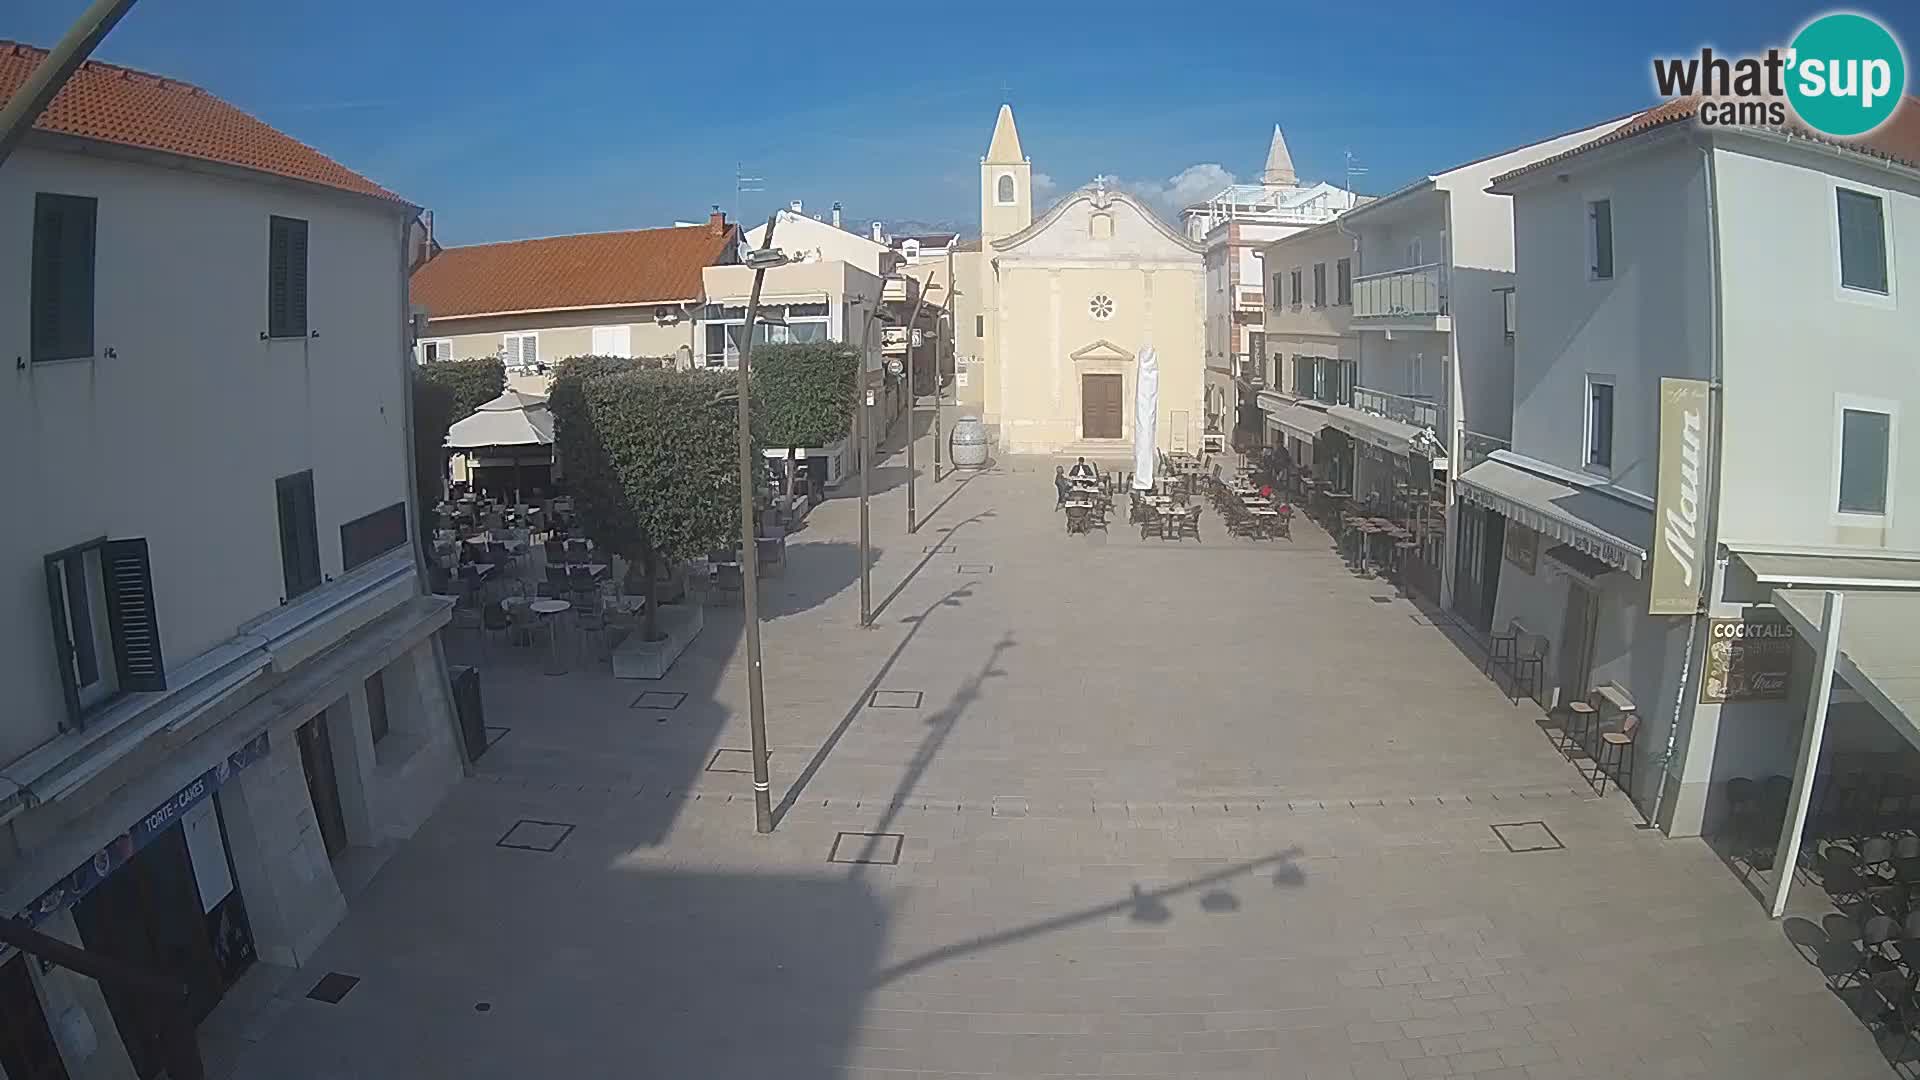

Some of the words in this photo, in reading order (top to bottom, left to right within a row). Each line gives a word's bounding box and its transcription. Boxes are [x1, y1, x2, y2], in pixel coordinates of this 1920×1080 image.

[1664, 408, 1701, 587] Maun
[1714, 623, 1793, 638] COCKTAILS
[144, 803, 174, 832] TORTE
[178, 779, 205, 807] CAKES
